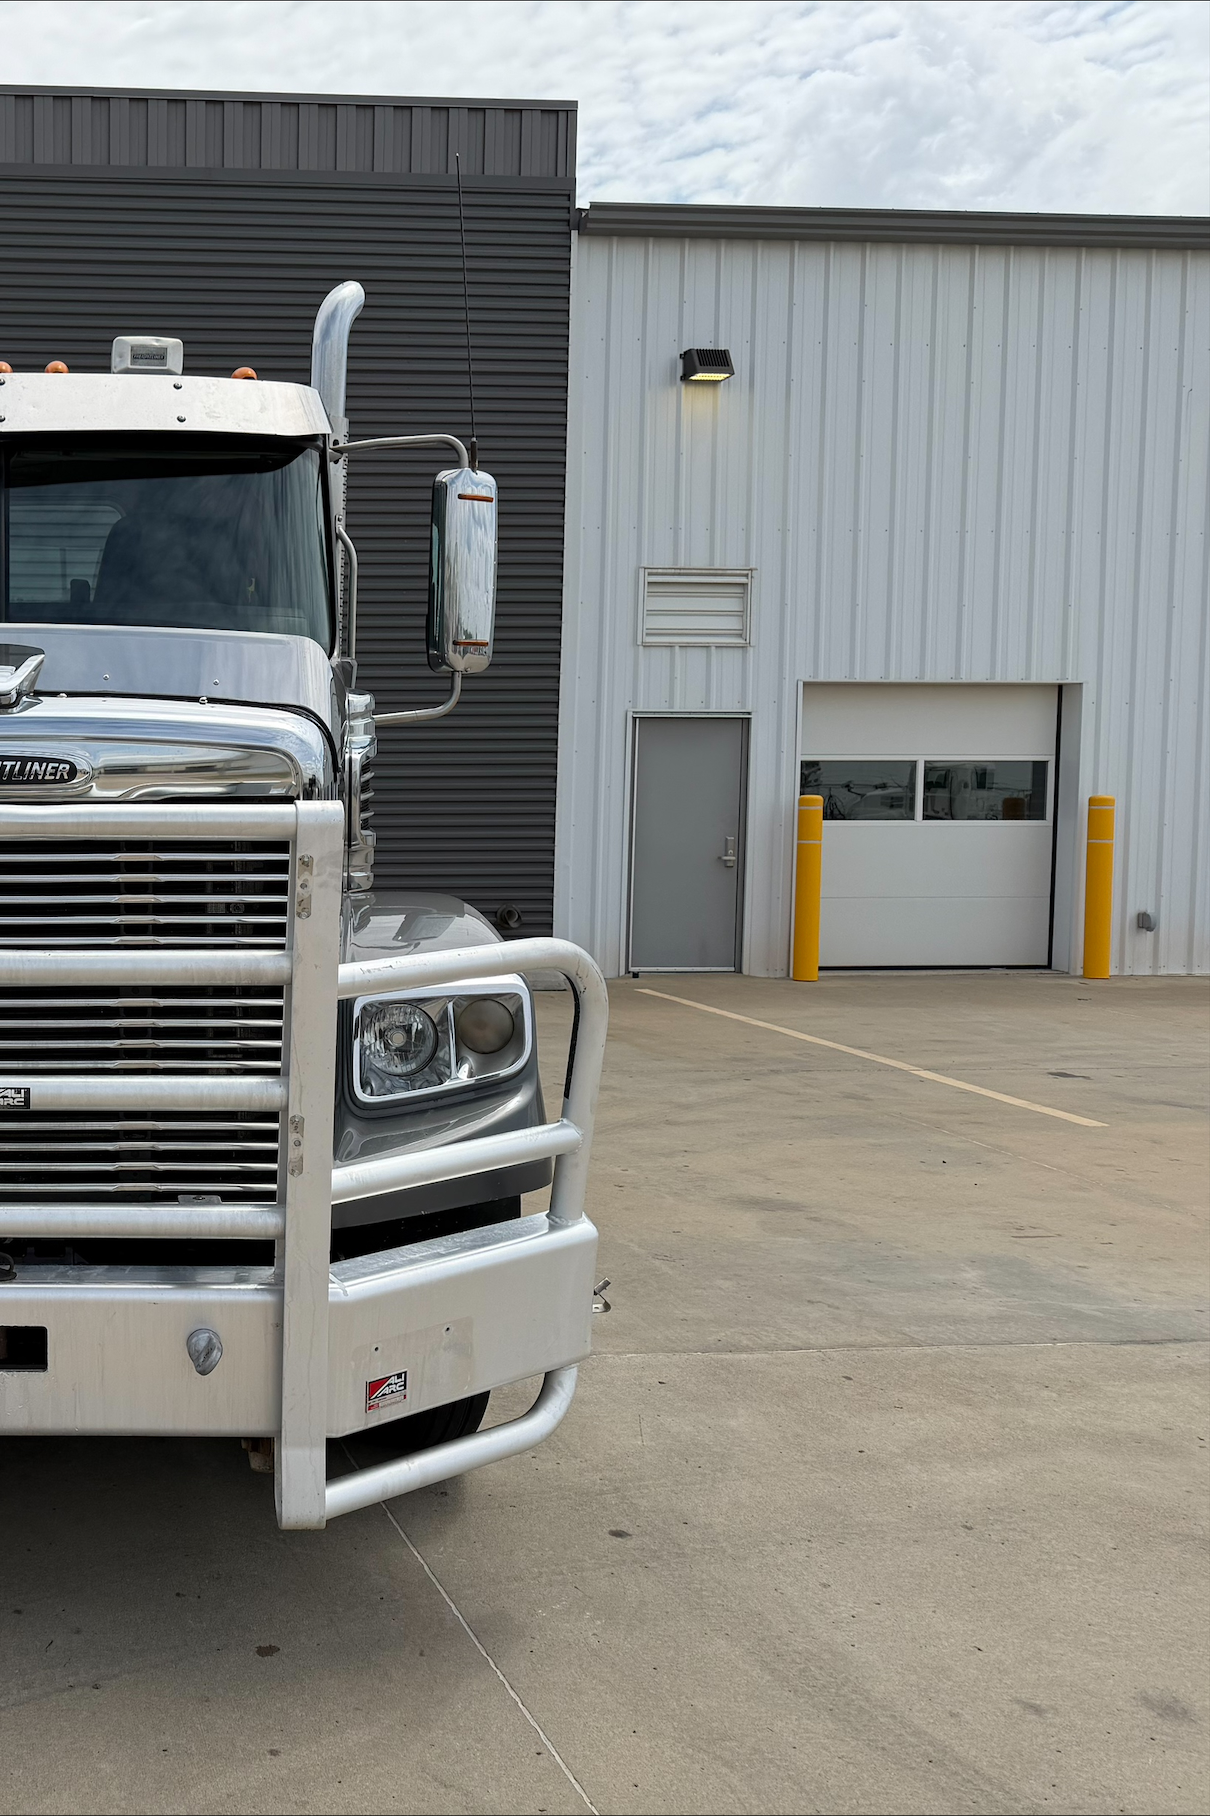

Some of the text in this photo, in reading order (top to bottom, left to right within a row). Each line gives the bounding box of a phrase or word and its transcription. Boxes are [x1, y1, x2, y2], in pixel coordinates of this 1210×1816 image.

[0, 1088, 25, 1098] ALI
[388, 1373, 405, 1385] ALI
[377, 1382, 405, 1397] ARC
